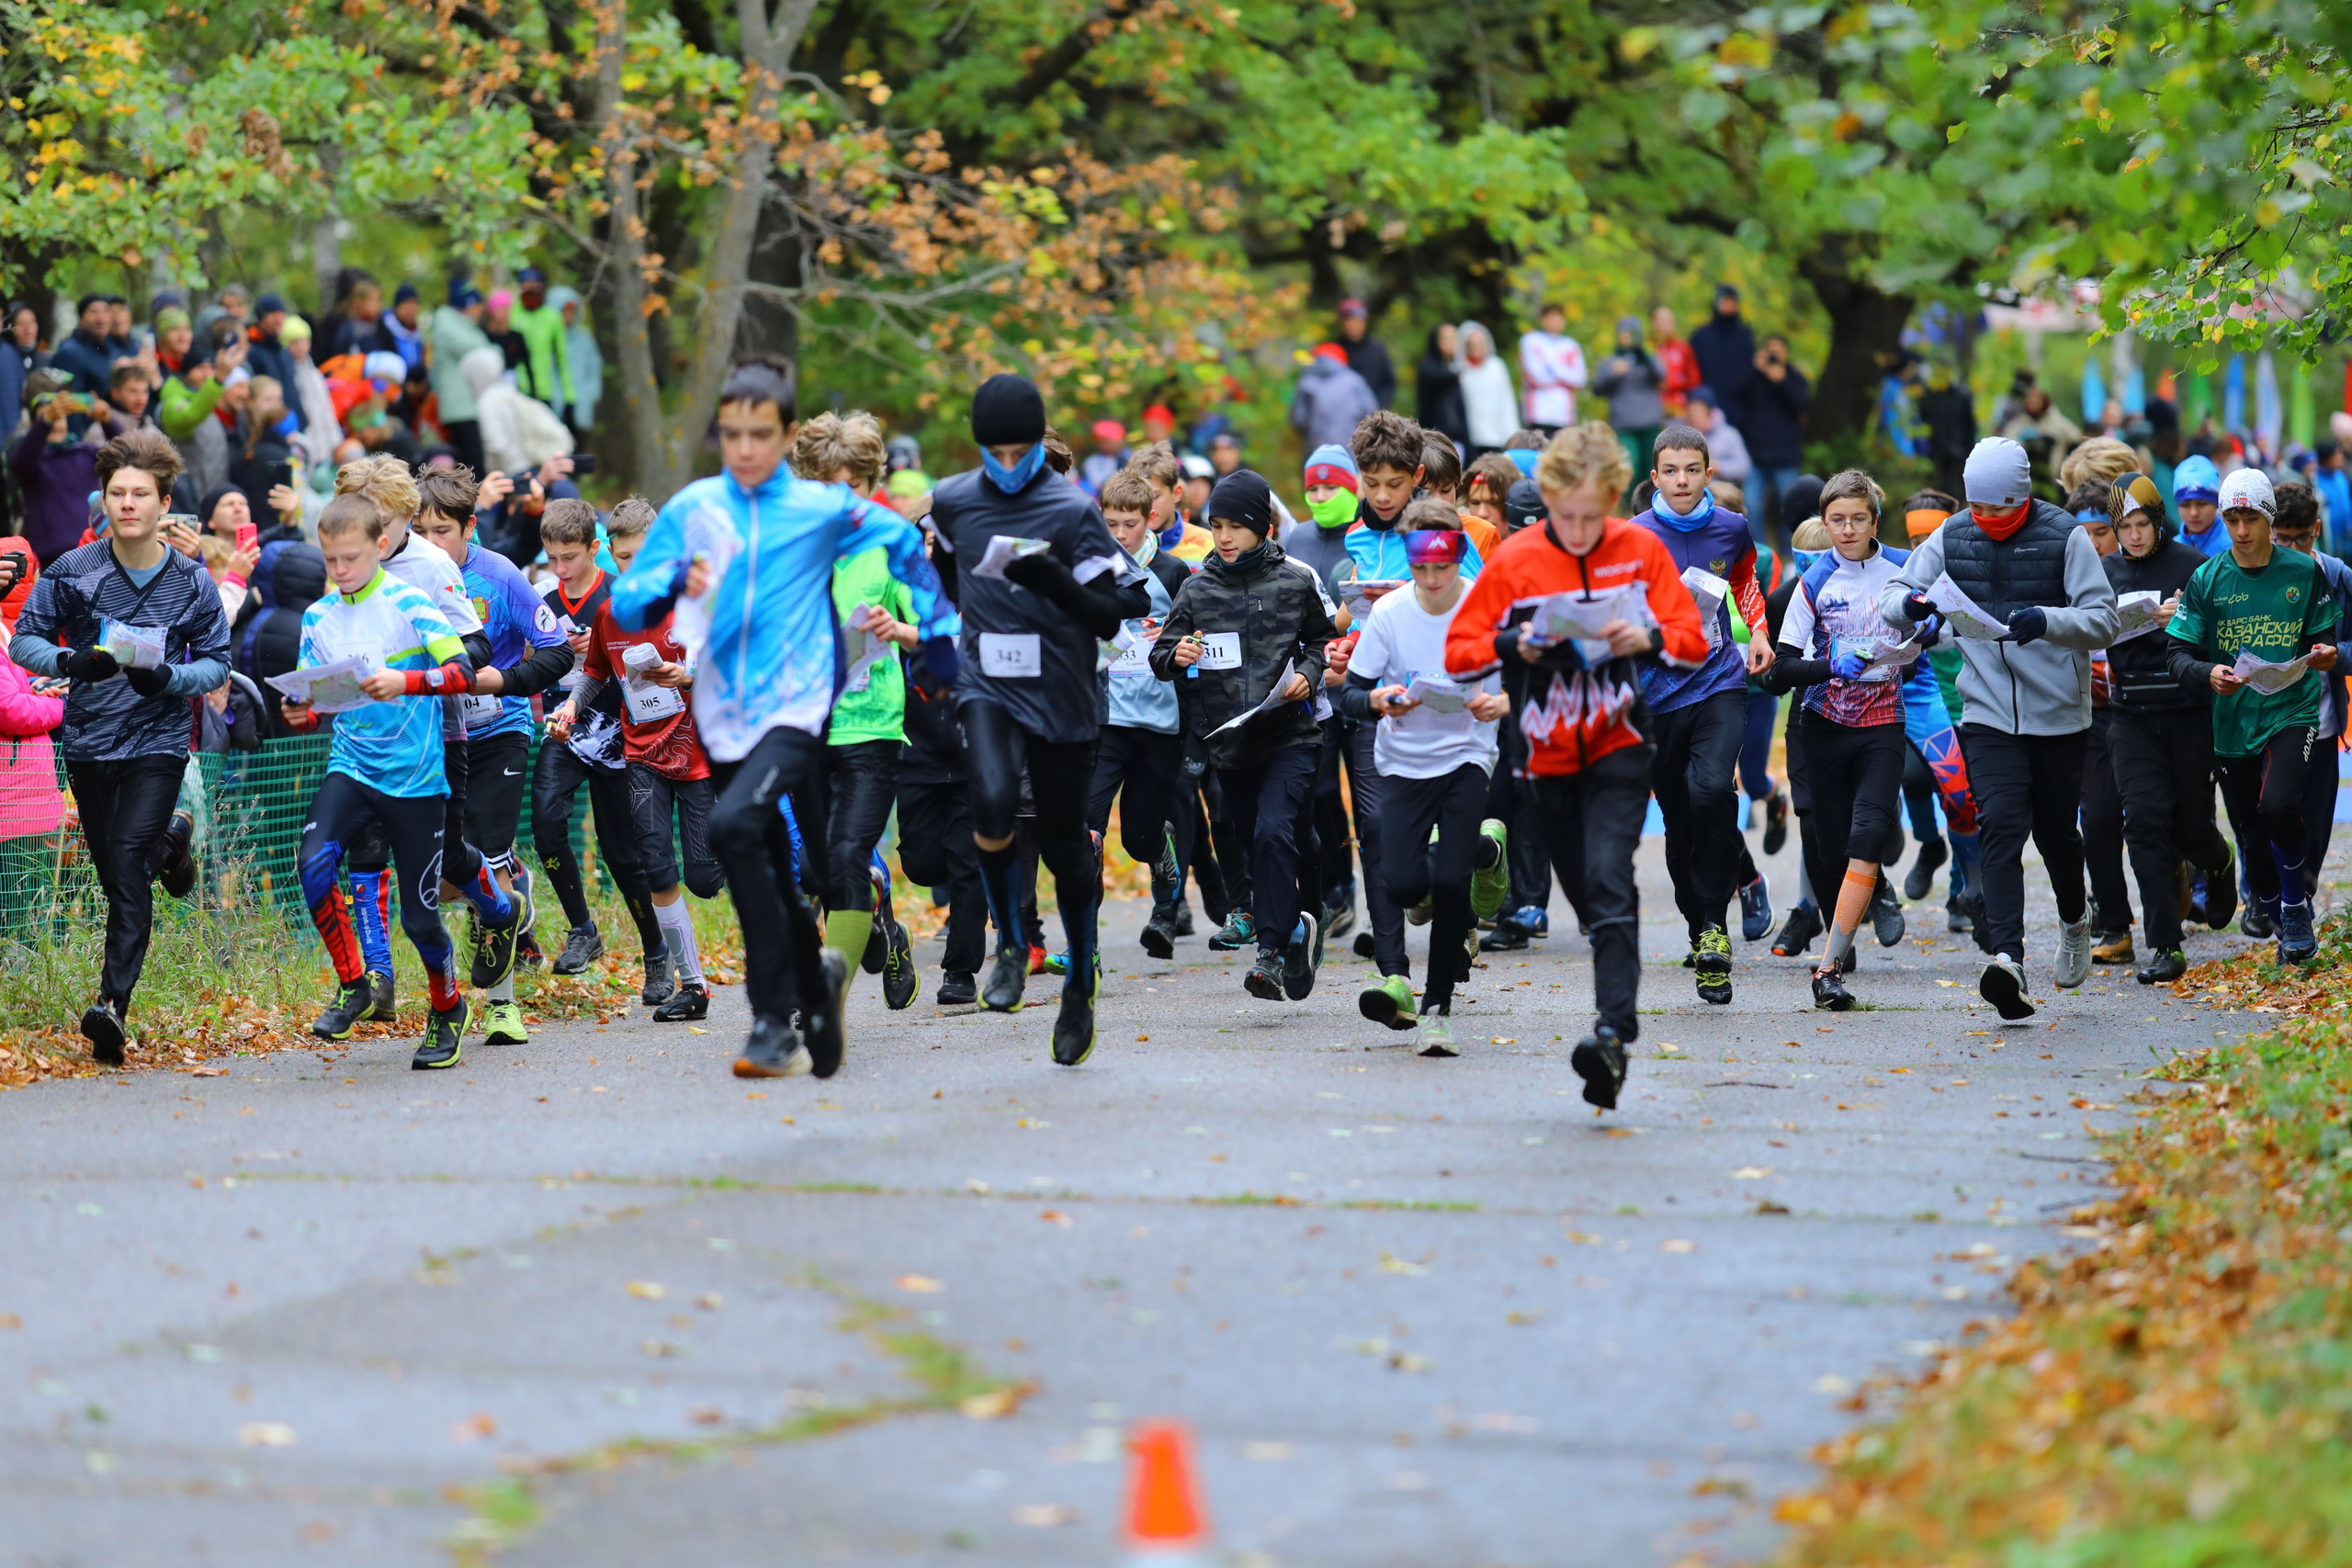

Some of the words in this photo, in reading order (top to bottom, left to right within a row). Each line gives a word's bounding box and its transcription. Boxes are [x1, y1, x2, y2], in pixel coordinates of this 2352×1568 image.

[2227, 616, 2247, 625] БАРС
[2249, 614, 2271, 623] БАНК
[2216, 618, 2303, 638] КАЗАНСКИЙ
[2218, 634, 2299, 651] МАРАФОН
[995, 649, 1022, 664] 342
[1204, 647, 1224, 659] 311
[463, 696, 481, 709] 04
[639, 696, 661, 710] 305
